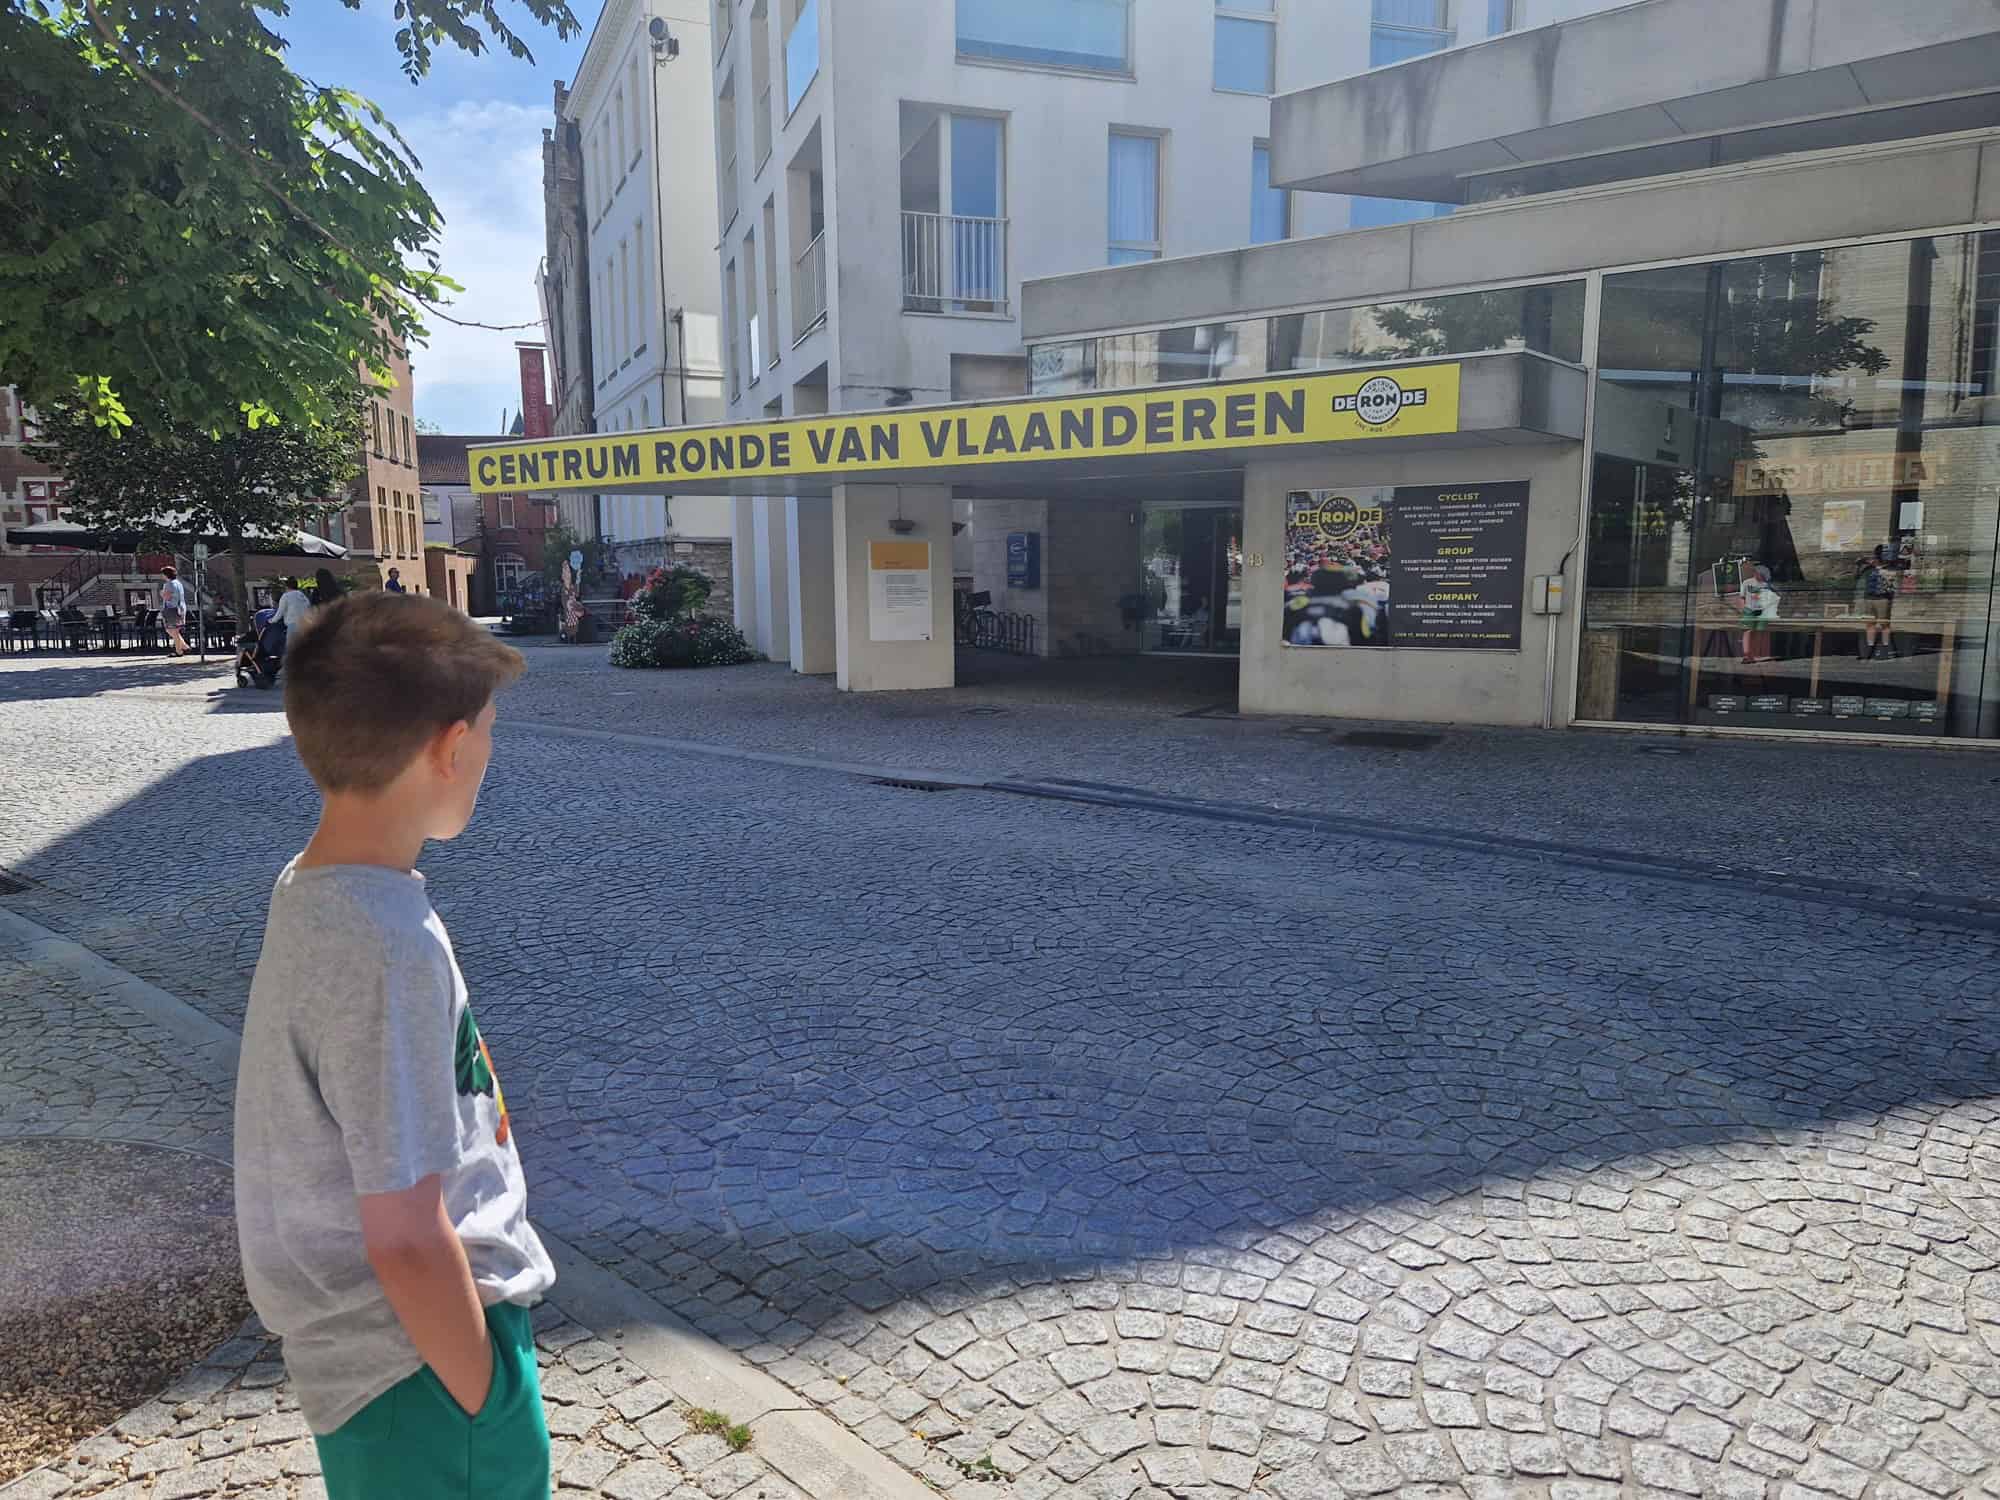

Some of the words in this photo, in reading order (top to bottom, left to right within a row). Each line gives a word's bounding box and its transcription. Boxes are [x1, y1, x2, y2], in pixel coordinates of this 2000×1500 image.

[478, 444, 640, 486] CENTRUM
[655, 431, 790, 474] RONDE
[807, 423, 899, 464] VAN
[919, 389, 1305, 458] VLAANDEREN
[1438, 493, 1480, 502] CYCLIST
[1437, 547, 1474, 556] GROUP
[1428, 593, 1479, 601] COMPANY
